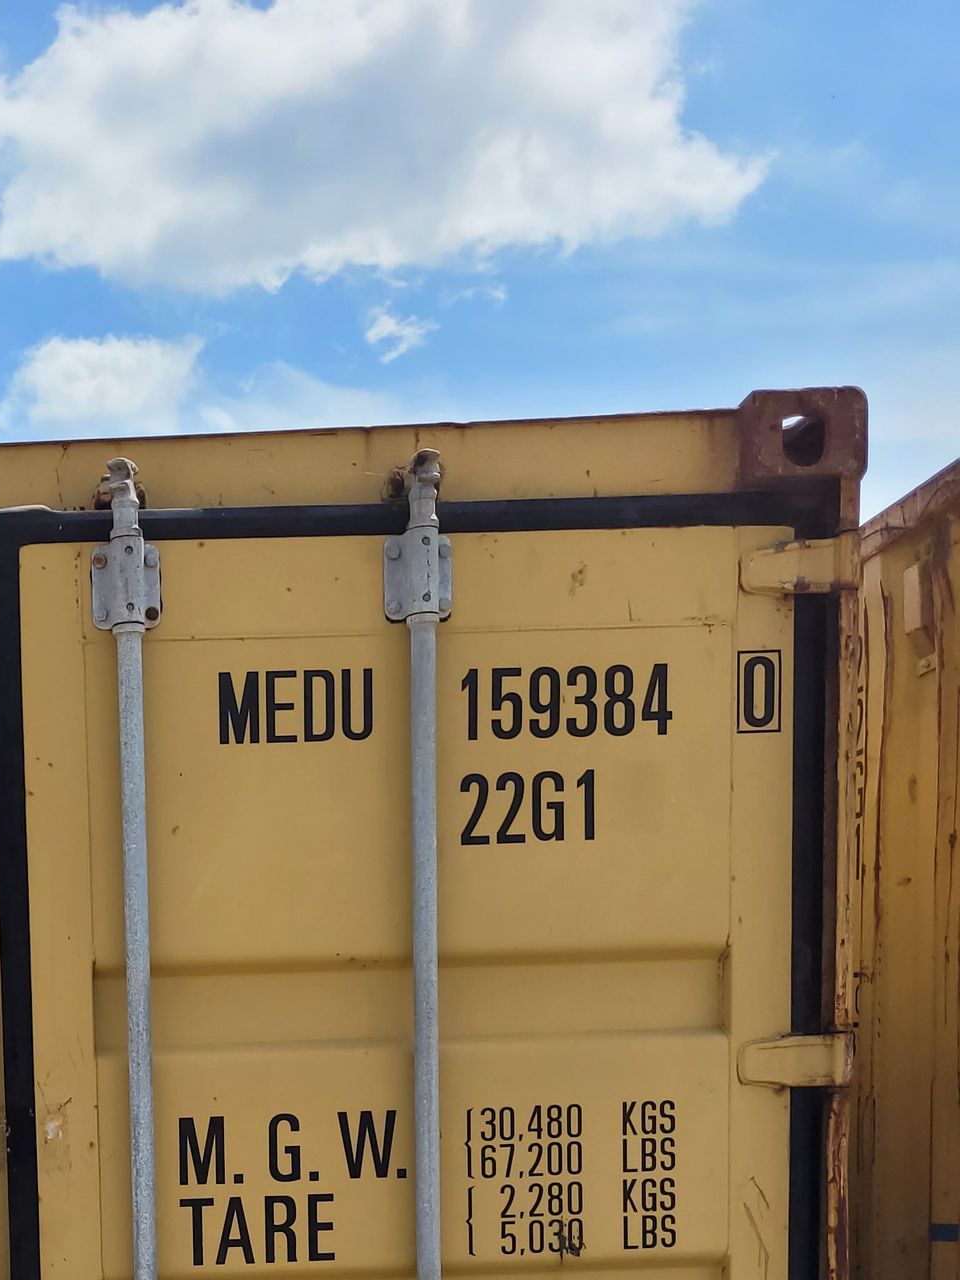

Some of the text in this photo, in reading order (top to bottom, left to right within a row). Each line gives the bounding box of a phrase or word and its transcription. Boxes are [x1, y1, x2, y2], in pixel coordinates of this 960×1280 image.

[218, 655, 776, 745] MEDU 159384 0
[459, 768, 596, 846] 22G1
[480, 1099, 677, 1142] 30,480 KGS
[480, 1136, 677, 1179] 67,200 LBS
[499, 1177, 677, 1219] 2,280 KGS
[179, 1193, 336, 1267] TARE
[500, 1213, 677, 1257] 5,030 LBS
